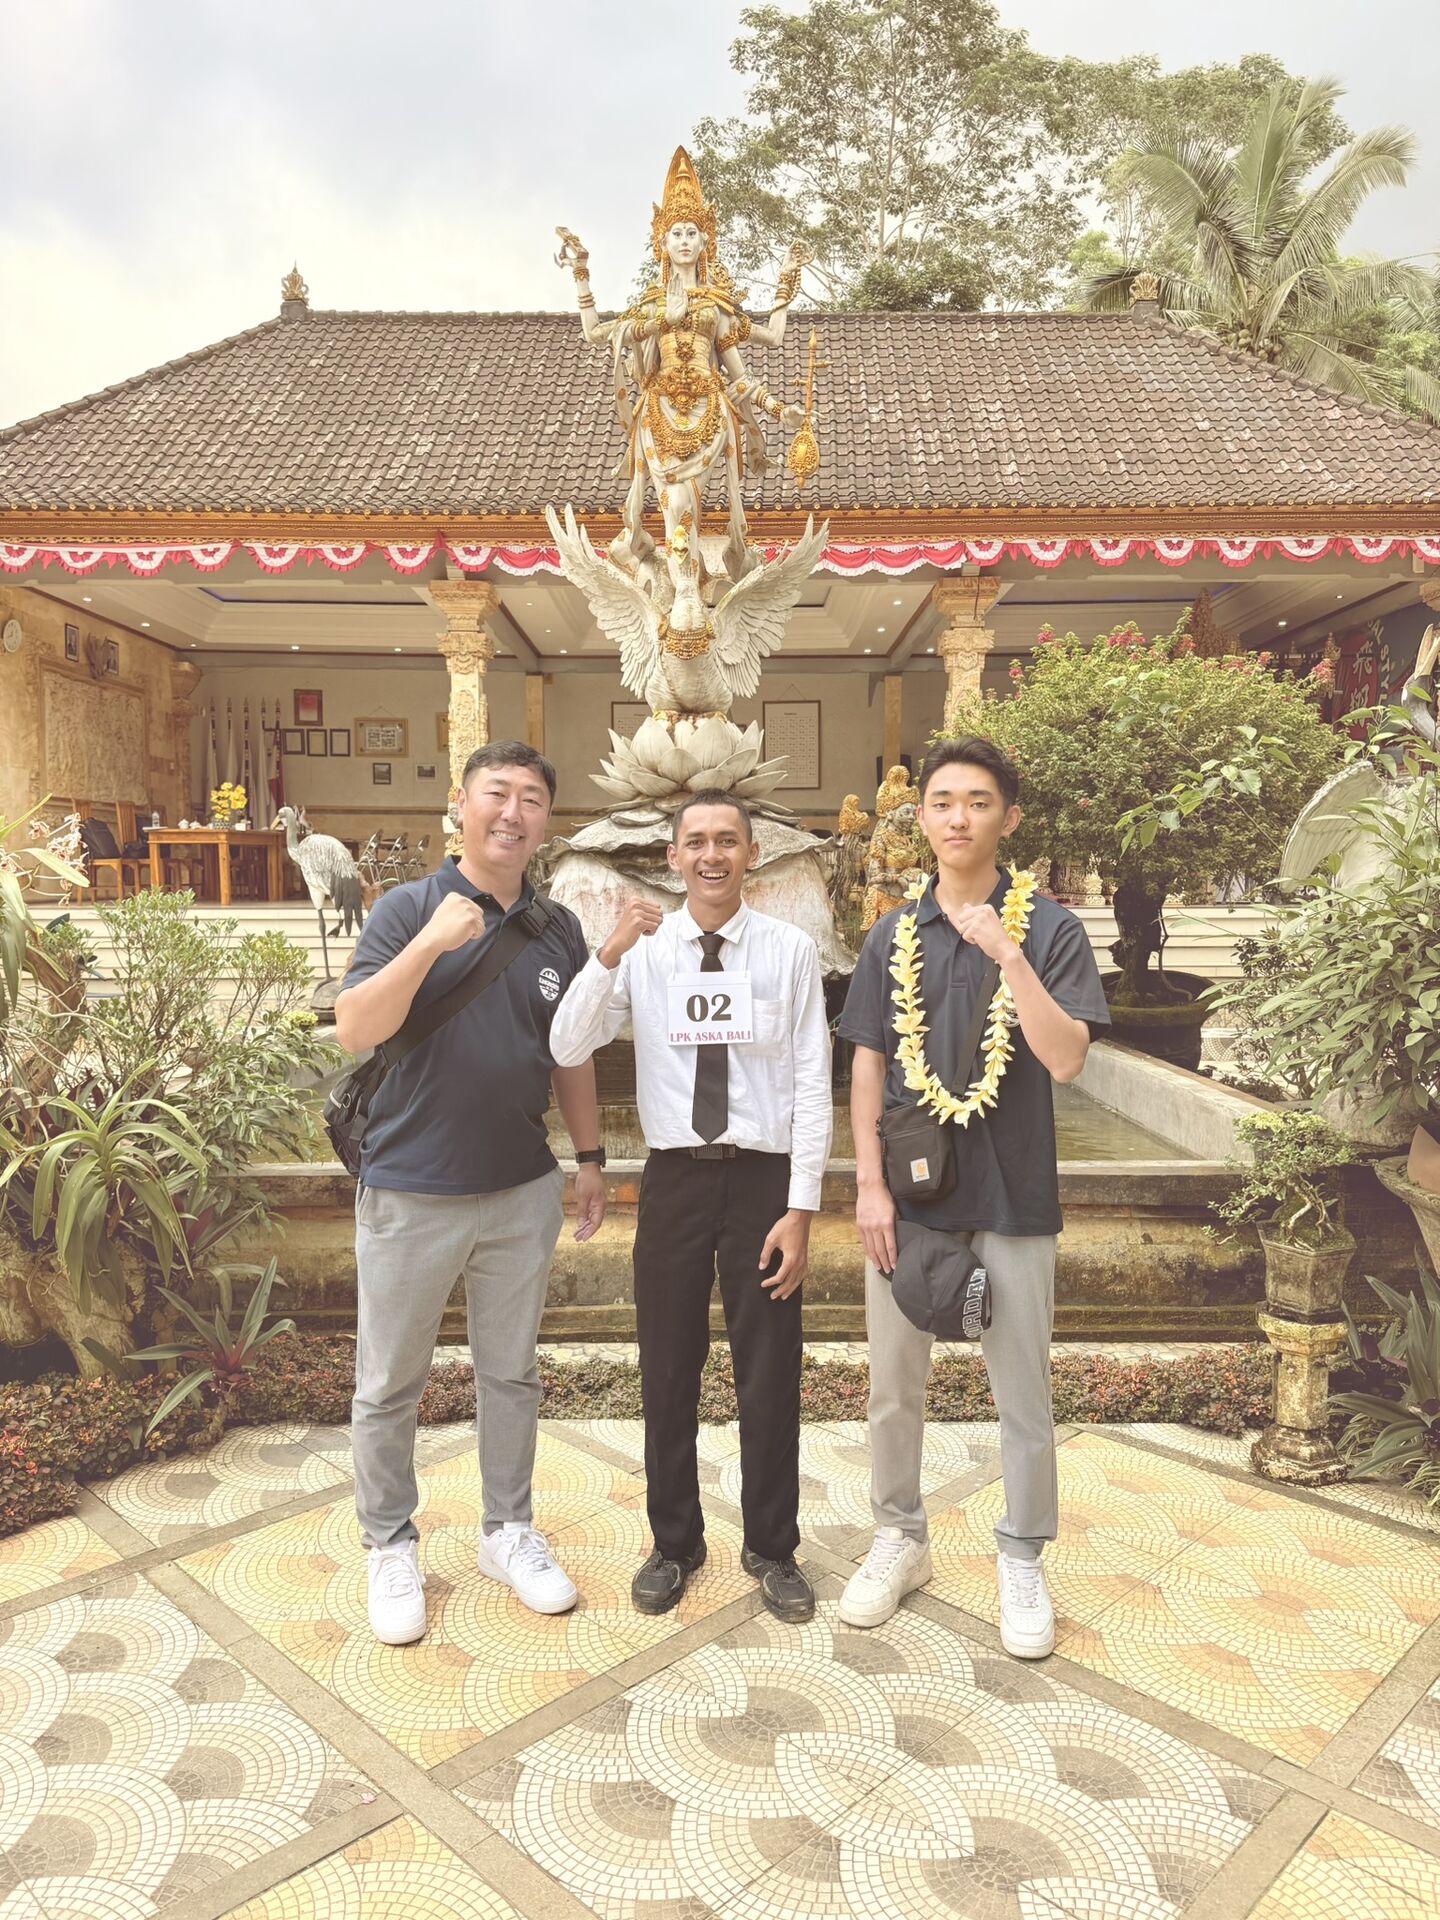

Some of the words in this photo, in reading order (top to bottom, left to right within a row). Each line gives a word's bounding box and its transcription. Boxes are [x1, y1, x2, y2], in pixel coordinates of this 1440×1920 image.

[686, 993, 732, 1022] 02
[670, 1032, 692, 1042] LPK
[694, 1031, 723, 1042] ASKA
[726, 1030, 751, 1041] BALI
